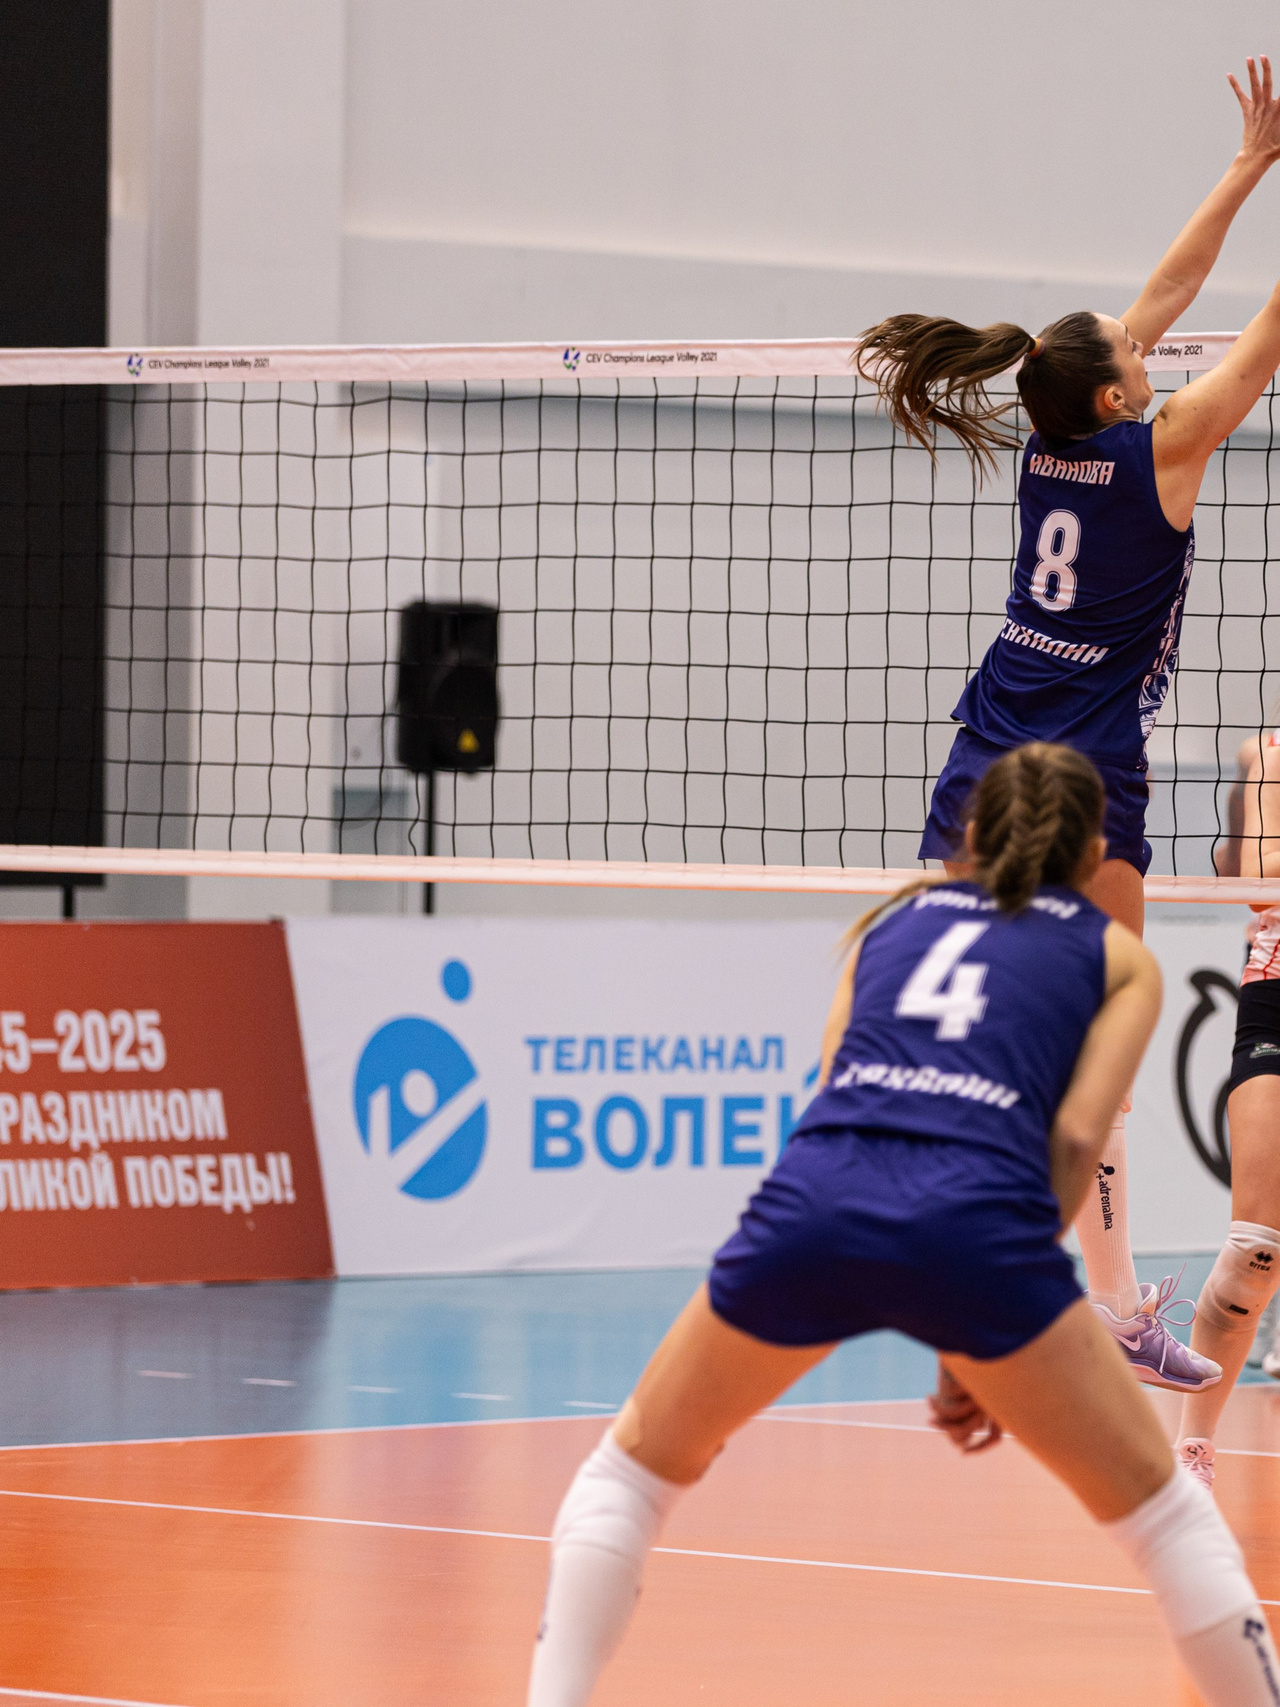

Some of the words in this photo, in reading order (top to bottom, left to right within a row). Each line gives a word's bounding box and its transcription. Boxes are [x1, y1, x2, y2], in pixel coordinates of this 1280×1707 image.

[165, 359, 201, 370] Champions
[204, 359, 230, 370] League
[586, 353, 601, 363] CEV
[603, 352, 645, 364] Champions
[646, 353, 675, 364] League
[677, 352, 699, 363] Volley
[700, 352, 717, 362] 2021
[1158, 345, 1182, 358] Volley
[1184, 344, 1203, 355] 2021
[1030, 453, 1115, 485] ИВАНОВА
[1029, 508, 1082, 612] 8
[895, 919, 990, 1041] 4
[0, 1008, 167, 1074] 5–2025
[523, 1034, 785, 1074] ТЕЛЕКАНАЛ
[123, 1152, 296, 1214] ПОБЕДЫ!
